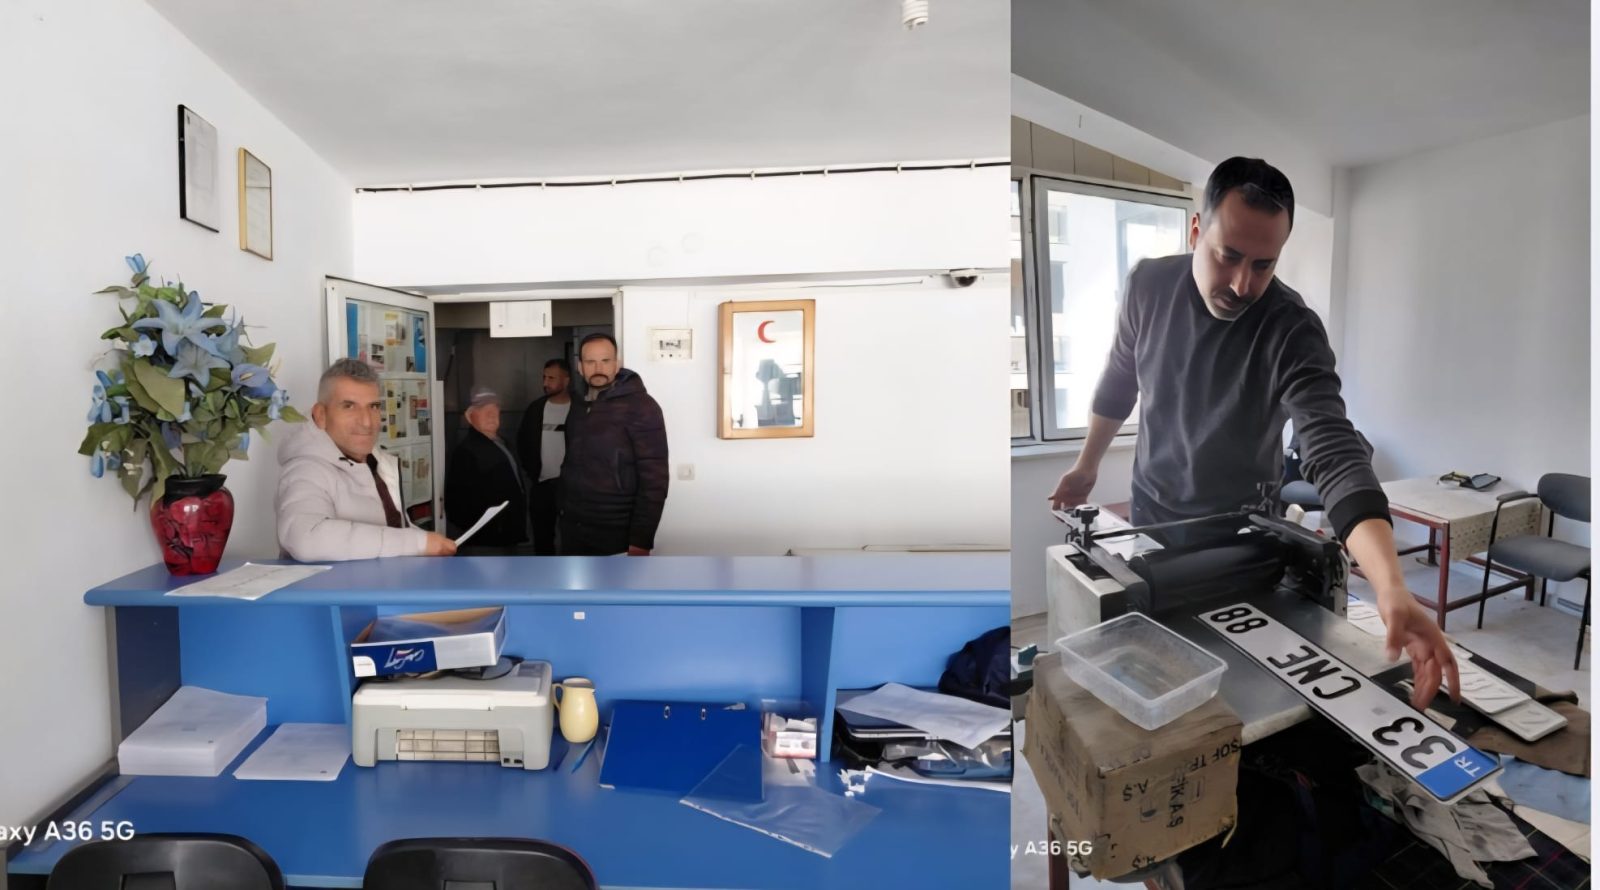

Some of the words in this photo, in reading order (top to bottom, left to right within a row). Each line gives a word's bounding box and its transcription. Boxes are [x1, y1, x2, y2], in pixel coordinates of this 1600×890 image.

[1210, 607, 1269, 634] 88
[1266, 645, 1361, 699] CNE
[1372, 716, 1456, 770] 33
[1454, 755, 1480, 778] TR
